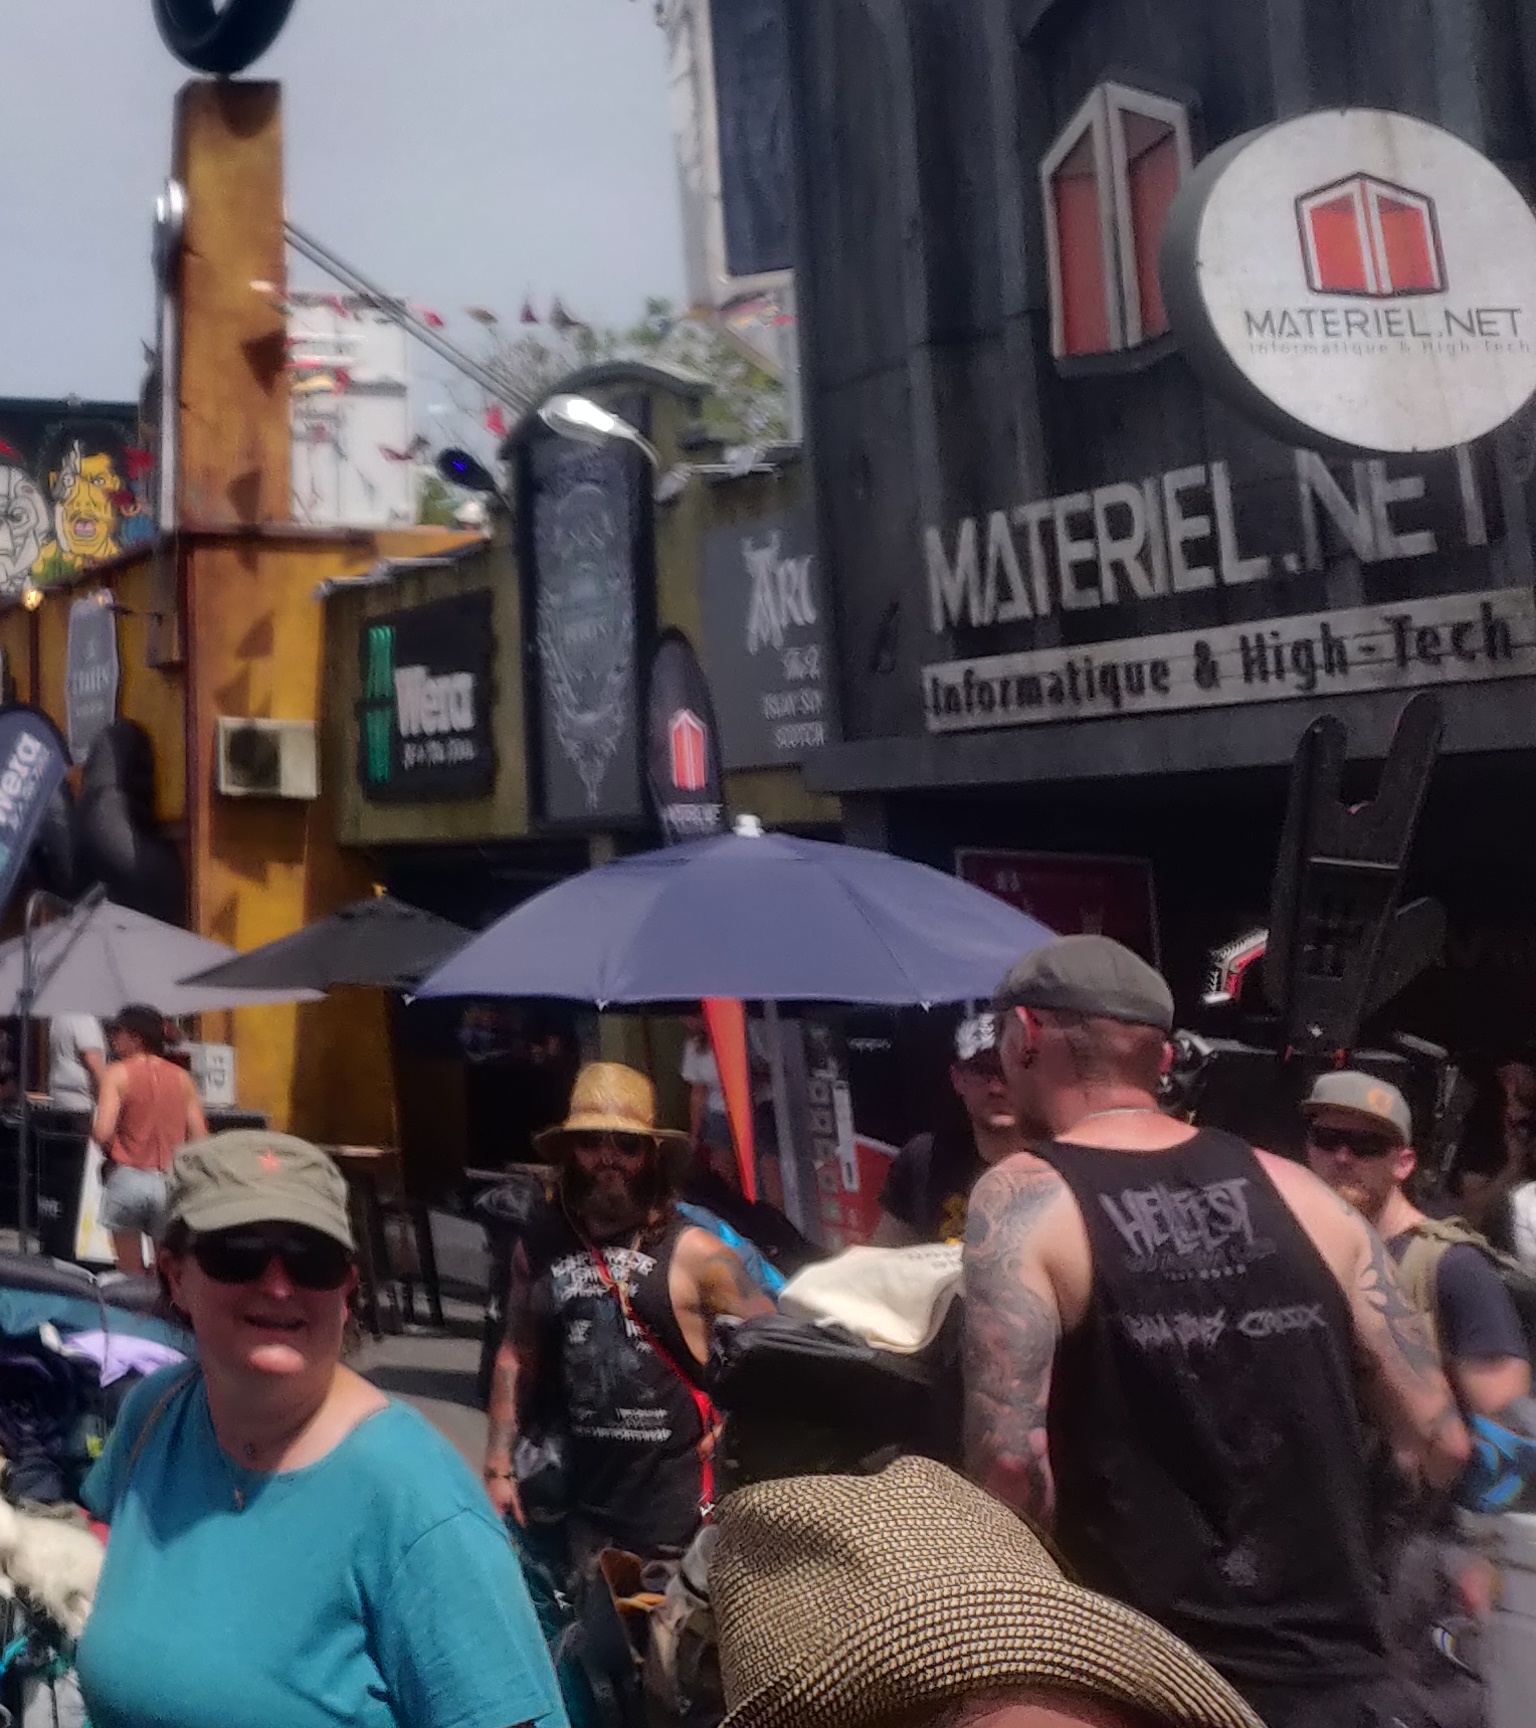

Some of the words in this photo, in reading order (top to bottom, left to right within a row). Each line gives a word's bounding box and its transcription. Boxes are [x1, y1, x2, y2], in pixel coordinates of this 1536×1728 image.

[1243, 307, 1523, 339] MATERIEL.NET
[929, 656, 1171, 718] Informatique
[1192, 639, 1223, 692] &
[1097, 1176, 1256, 1257] HELLFEST
